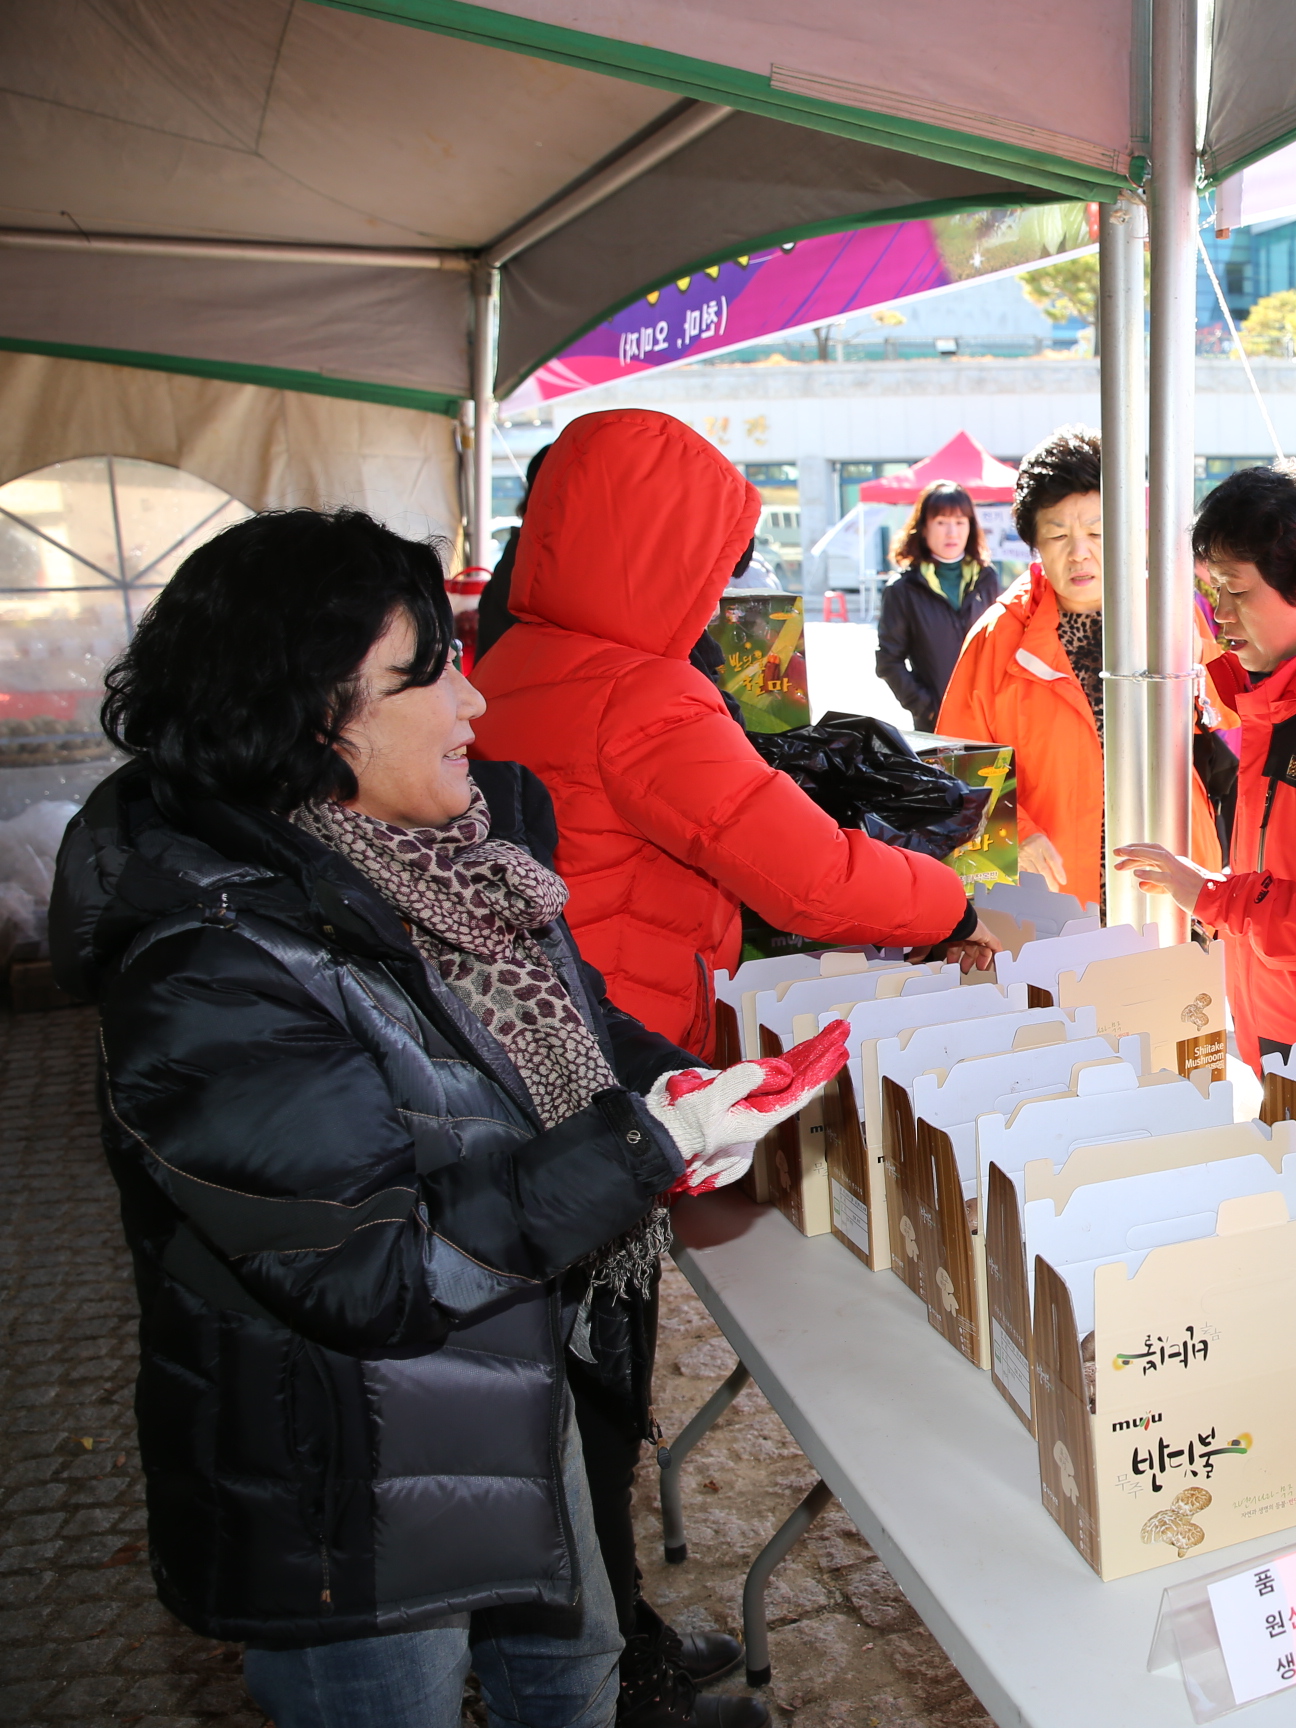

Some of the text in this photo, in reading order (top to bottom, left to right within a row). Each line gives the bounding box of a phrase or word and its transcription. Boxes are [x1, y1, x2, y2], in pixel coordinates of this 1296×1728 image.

[743, 675, 793, 696] 천마
[1185, 1051, 1225, 1069] Mushroom
[1194, 1042, 1225, 1057] Shiitake
[1117, 1326, 1209, 1376] 반딧불
[1112, 1411, 1163, 1432] muju
[1132, 1426, 1248, 1493] 반딧불
[1115, 1473, 1144, 1499] 무주
[1254, 1568, 1276, 1597] 품
